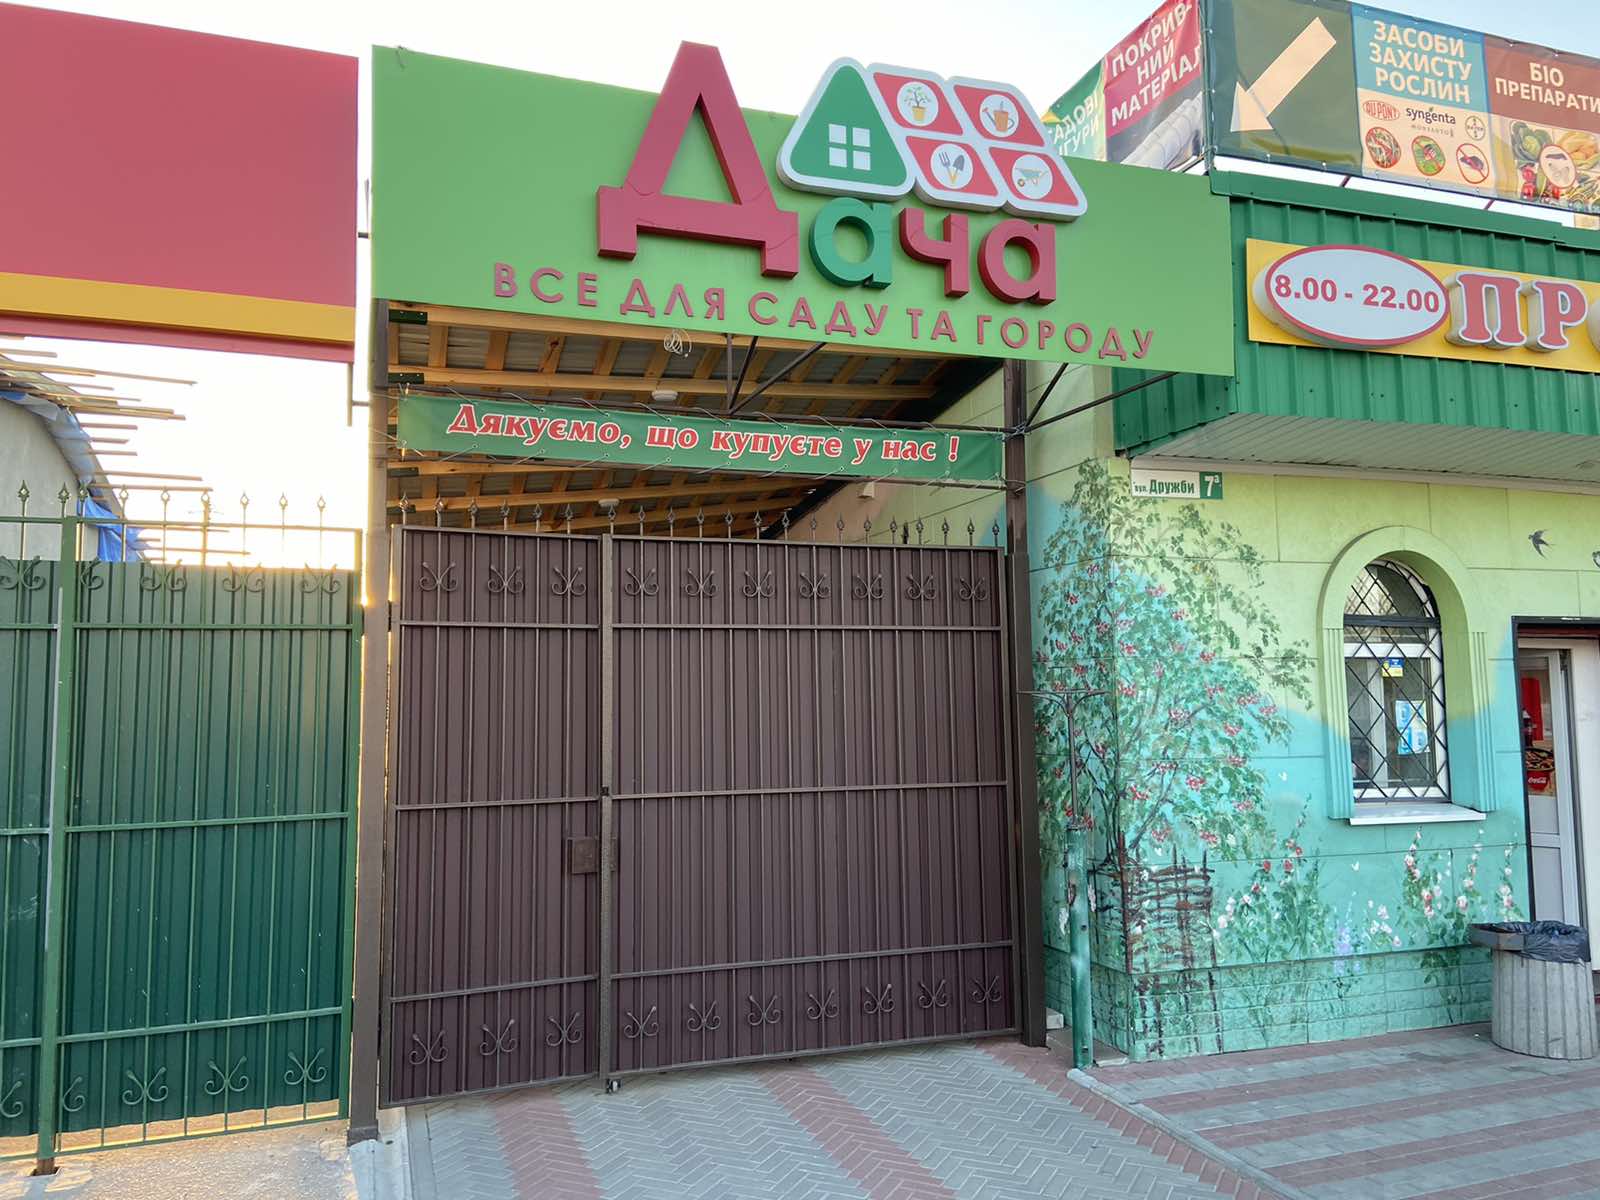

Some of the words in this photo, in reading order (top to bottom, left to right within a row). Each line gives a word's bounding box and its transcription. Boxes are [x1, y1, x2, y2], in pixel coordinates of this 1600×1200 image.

[1373, 20, 1464, 58] ЗАСОБИ
[1137, 37, 1175, 85] НИЙ
[1369, 42, 1472, 81] ЗАХИСТУ
[1529, 62, 1564, 87] БІО
[1376, 67, 1470, 104] РОСЛИН
[1495, 78, 1600, 115] ПРЕПАРАТИ
[1048, 89, 1099, 146] АДОВІ
[1406, 107, 1456, 125] syngenta
[597, 40, 1056, 305] Дача
[495, 262, 598, 307] ВСЕ
[620, 278, 725, 321] ДЛЯ
[748, 291, 888, 337] САДУ
[906, 308, 957, 342] ТА
[977, 314, 1154, 361] ГОРОДУ
[1275, 274, 1337, 302] 8.00
[1362, 283, 1440, 313] 22.00
[1456, 271, 1600, 351] ПР
[447, 404, 632, 449] Дякуємо,
[645, 425, 699, 449] що
[711, 430, 842, 461] купуєте
[851, 437, 872, 465] у
[881, 439, 937, 461] нас
[1149, 479, 1195, 495] Дружби
